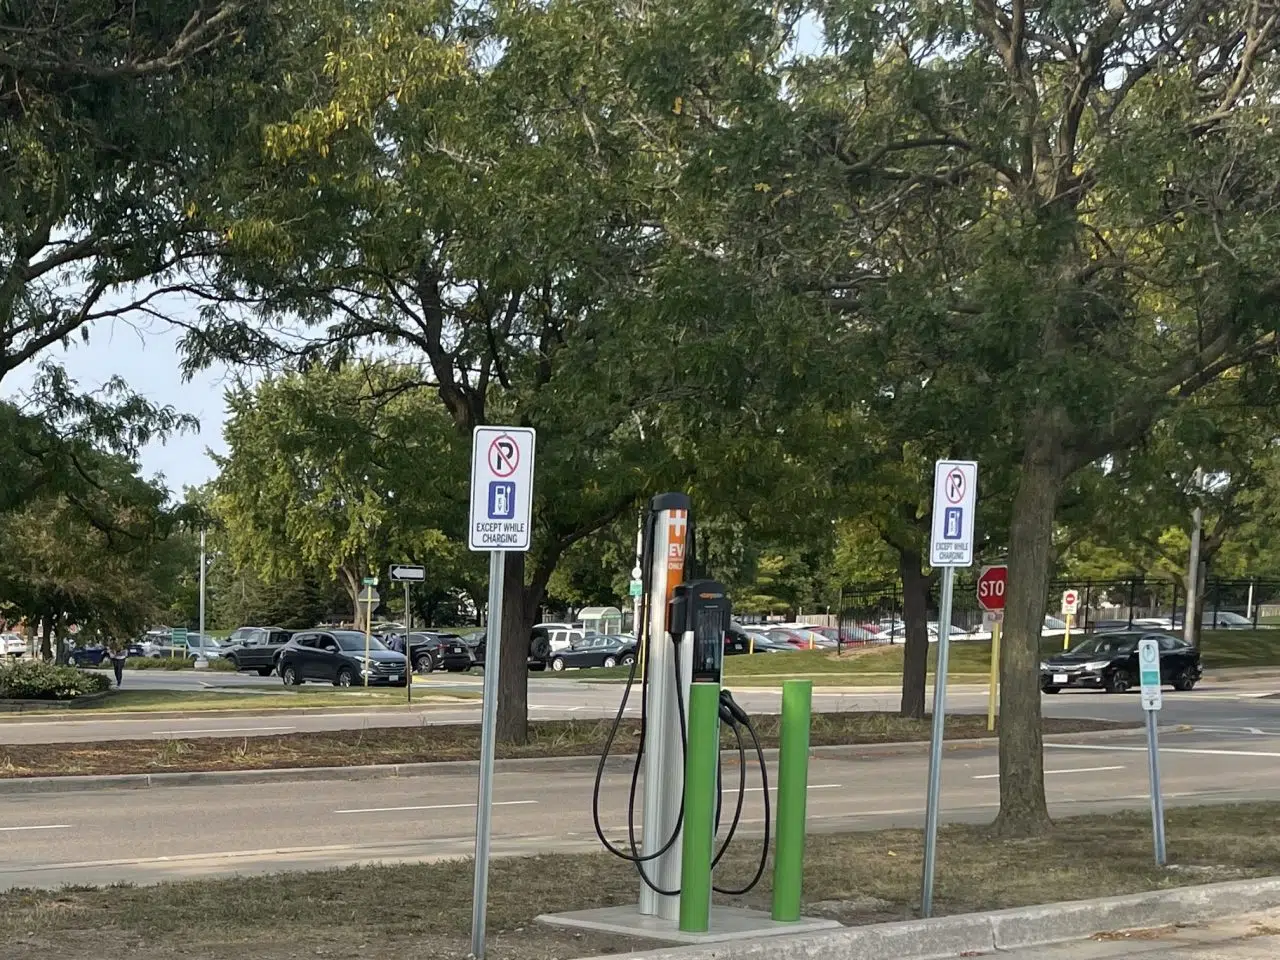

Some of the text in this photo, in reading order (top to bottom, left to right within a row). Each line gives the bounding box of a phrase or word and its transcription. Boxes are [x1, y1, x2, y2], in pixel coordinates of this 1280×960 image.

[476, 522, 525, 533] EXCEPT WHILE
[482, 533, 518, 543] CHARGING
[935, 542, 953, 551] EXCEPT
[938, 551, 965, 560] CHARGING
[980, 580, 1005, 597] STO
